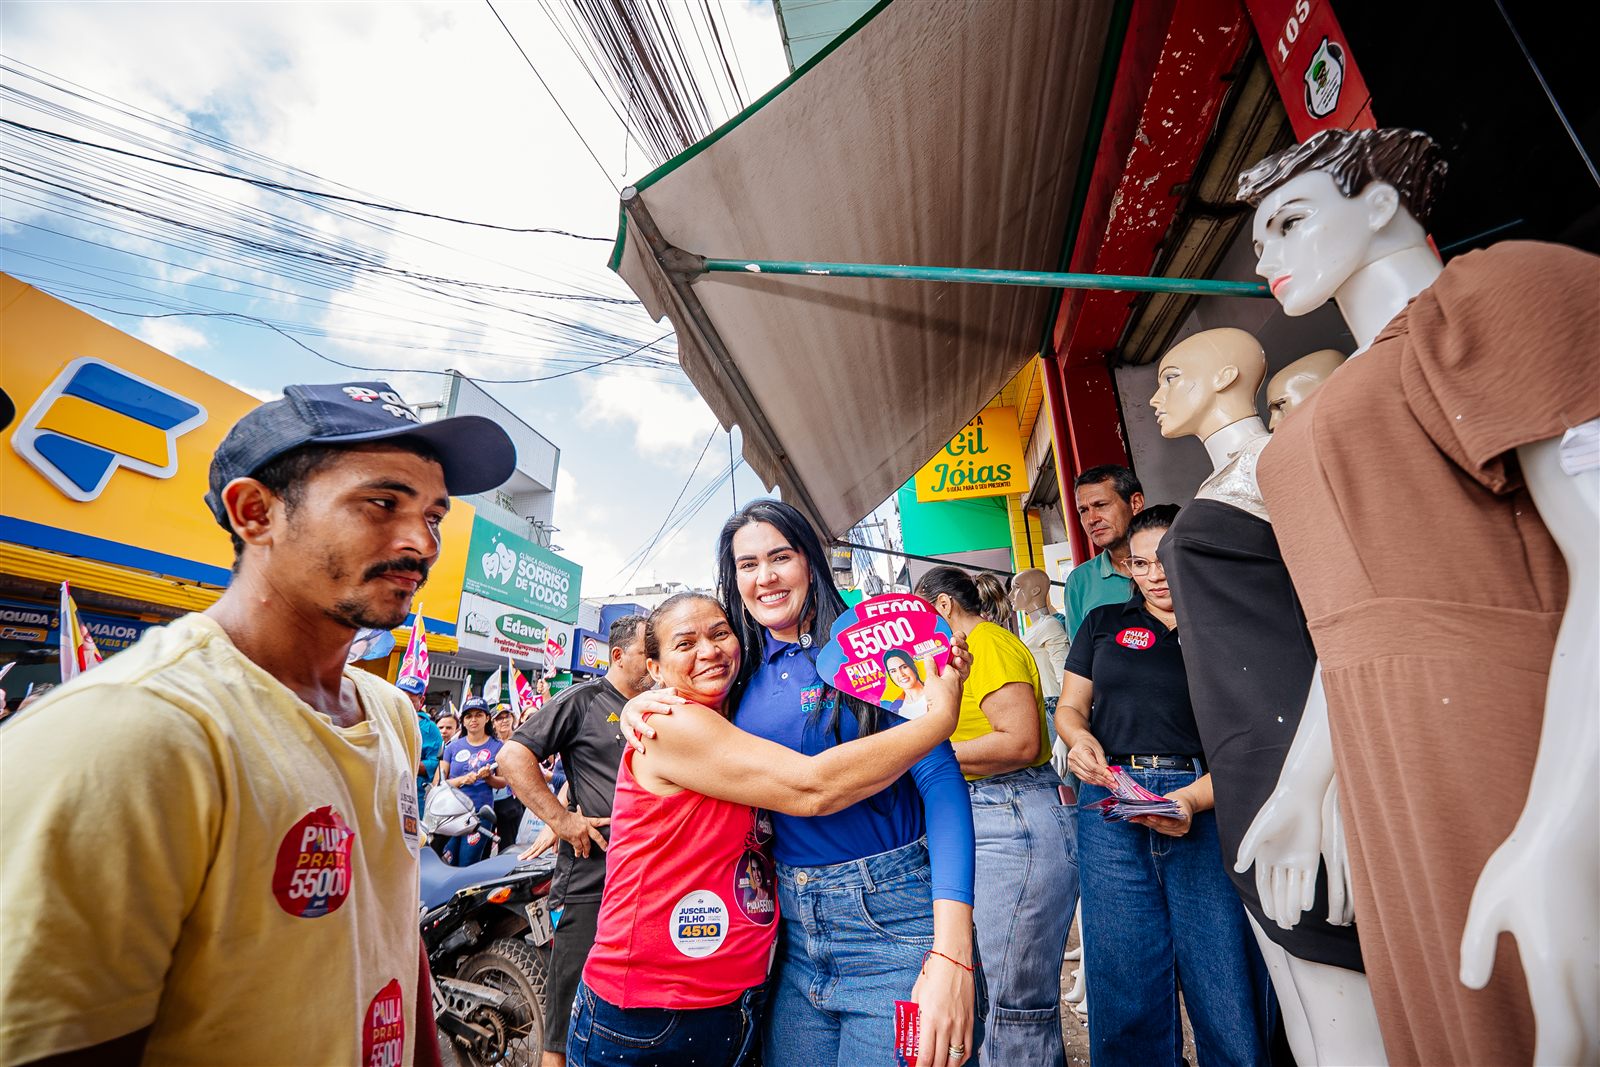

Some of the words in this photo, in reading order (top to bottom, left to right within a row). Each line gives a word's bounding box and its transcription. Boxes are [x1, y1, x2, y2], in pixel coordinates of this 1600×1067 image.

[945, 427, 989, 456] Gil
[931, 460, 1011, 492] Jóias
[517, 559, 570, 593] SORRISO
[515, 576, 528, 591] DE
[529, 581, 568, 609] TODOS
[86, 622, 136, 639] MAIOR
[502, 616, 547, 641] Edavet
[847, 617, 916, 659] 55000
[1125, 630, 1149, 639] PAULA
[845, 659, 882, 681] PAULA
[851, 671, 886, 688] PRATA
[296, 853, 346, 868] PRATA
[288, 867, 347, 899] 55000
[678, 915, 706, 924] FILHO
[679, 907, 720, 915] JUSCELINO
[681, 924, 718, 937] 4510
